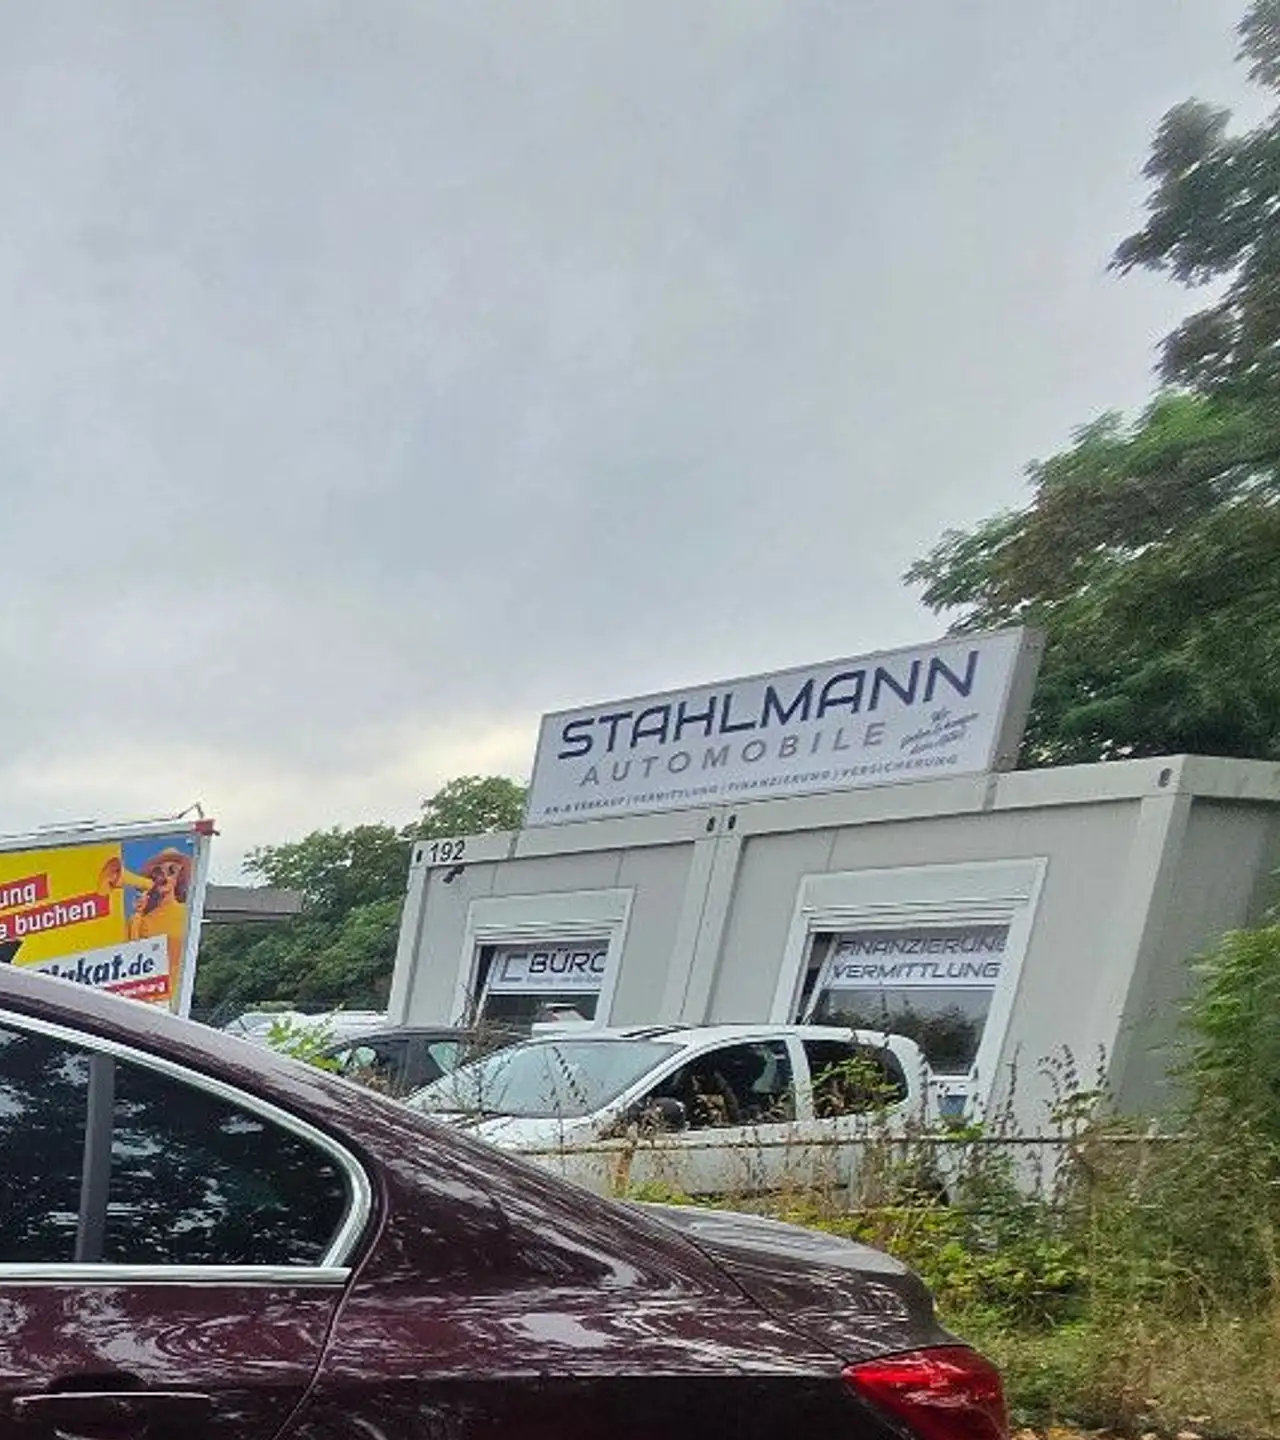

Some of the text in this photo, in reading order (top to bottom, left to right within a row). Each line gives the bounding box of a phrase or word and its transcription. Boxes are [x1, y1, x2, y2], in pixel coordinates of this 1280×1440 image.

[557, 650, 980, 760] STAHLMANN
[579, 721, 886, 788] AUTOMOBILE
[727, 770, 830, 791] FINANZIERUNG
[842, 754, 959, 777] VERSICHERUNG
[430, 839, 466, 863] 192
[14, 899, 97, 936] buchen
[833, 961, 1002, 979] VERMITTLUNG
